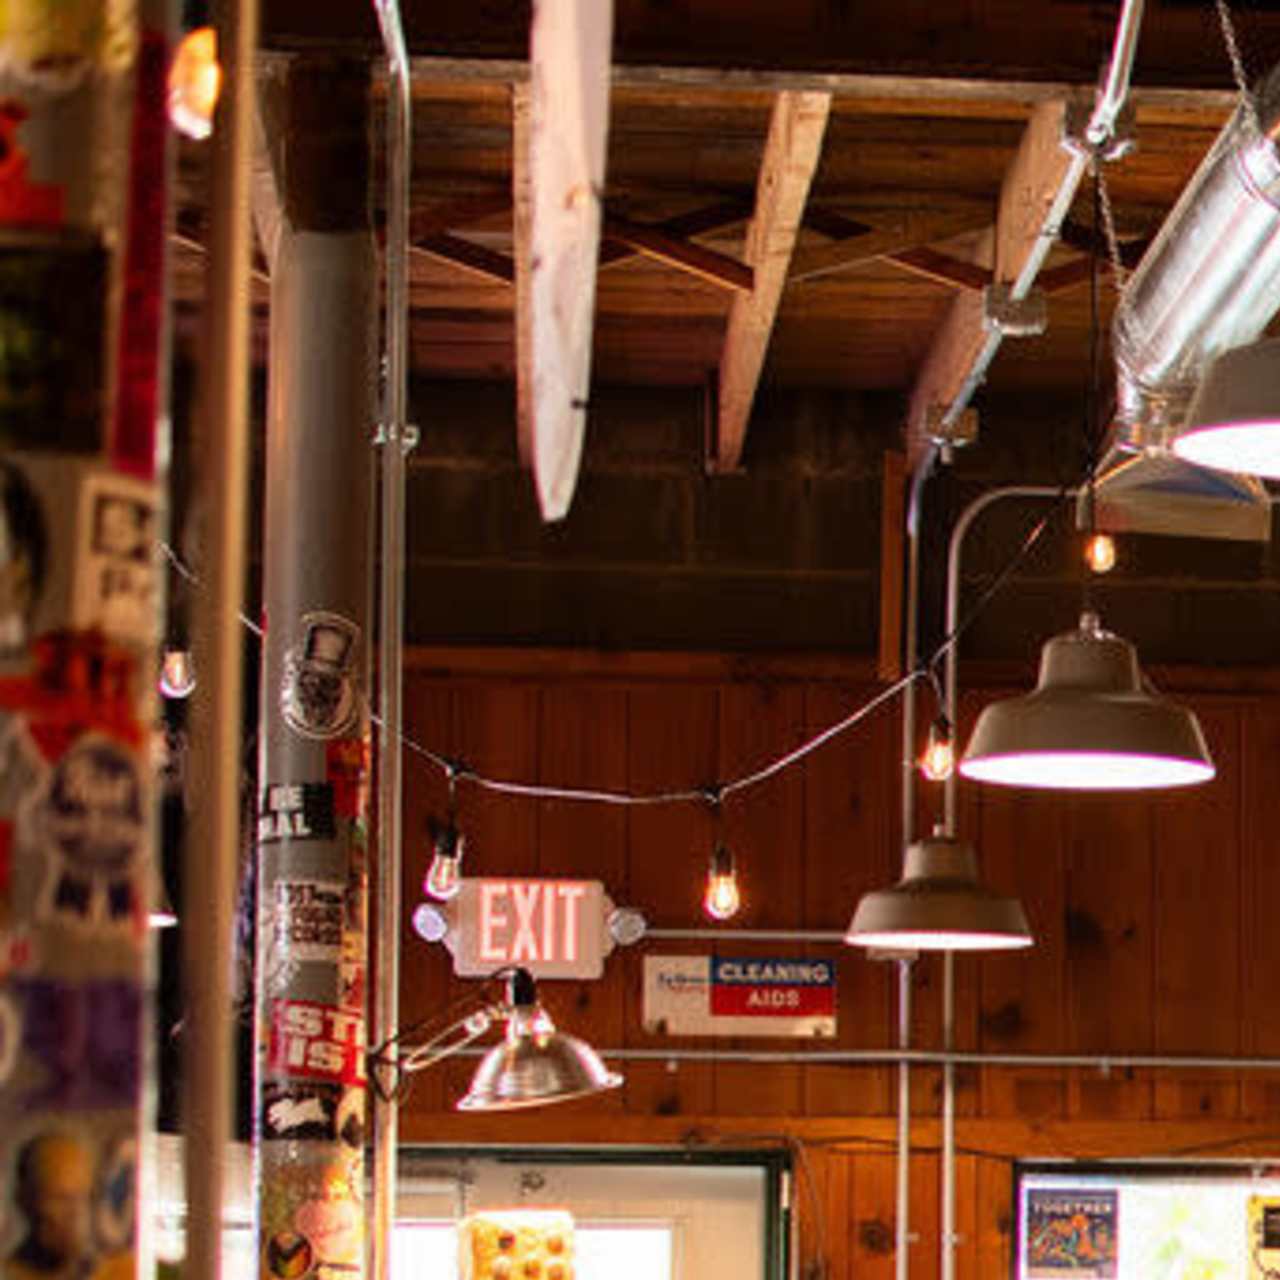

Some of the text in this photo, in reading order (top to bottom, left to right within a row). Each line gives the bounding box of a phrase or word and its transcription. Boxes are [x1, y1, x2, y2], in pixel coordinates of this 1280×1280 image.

[479, 882, 585, 962] EXIT
[719, 961, 829, 983] CLEANING
[747, 988, 801, 1008] AIDS
